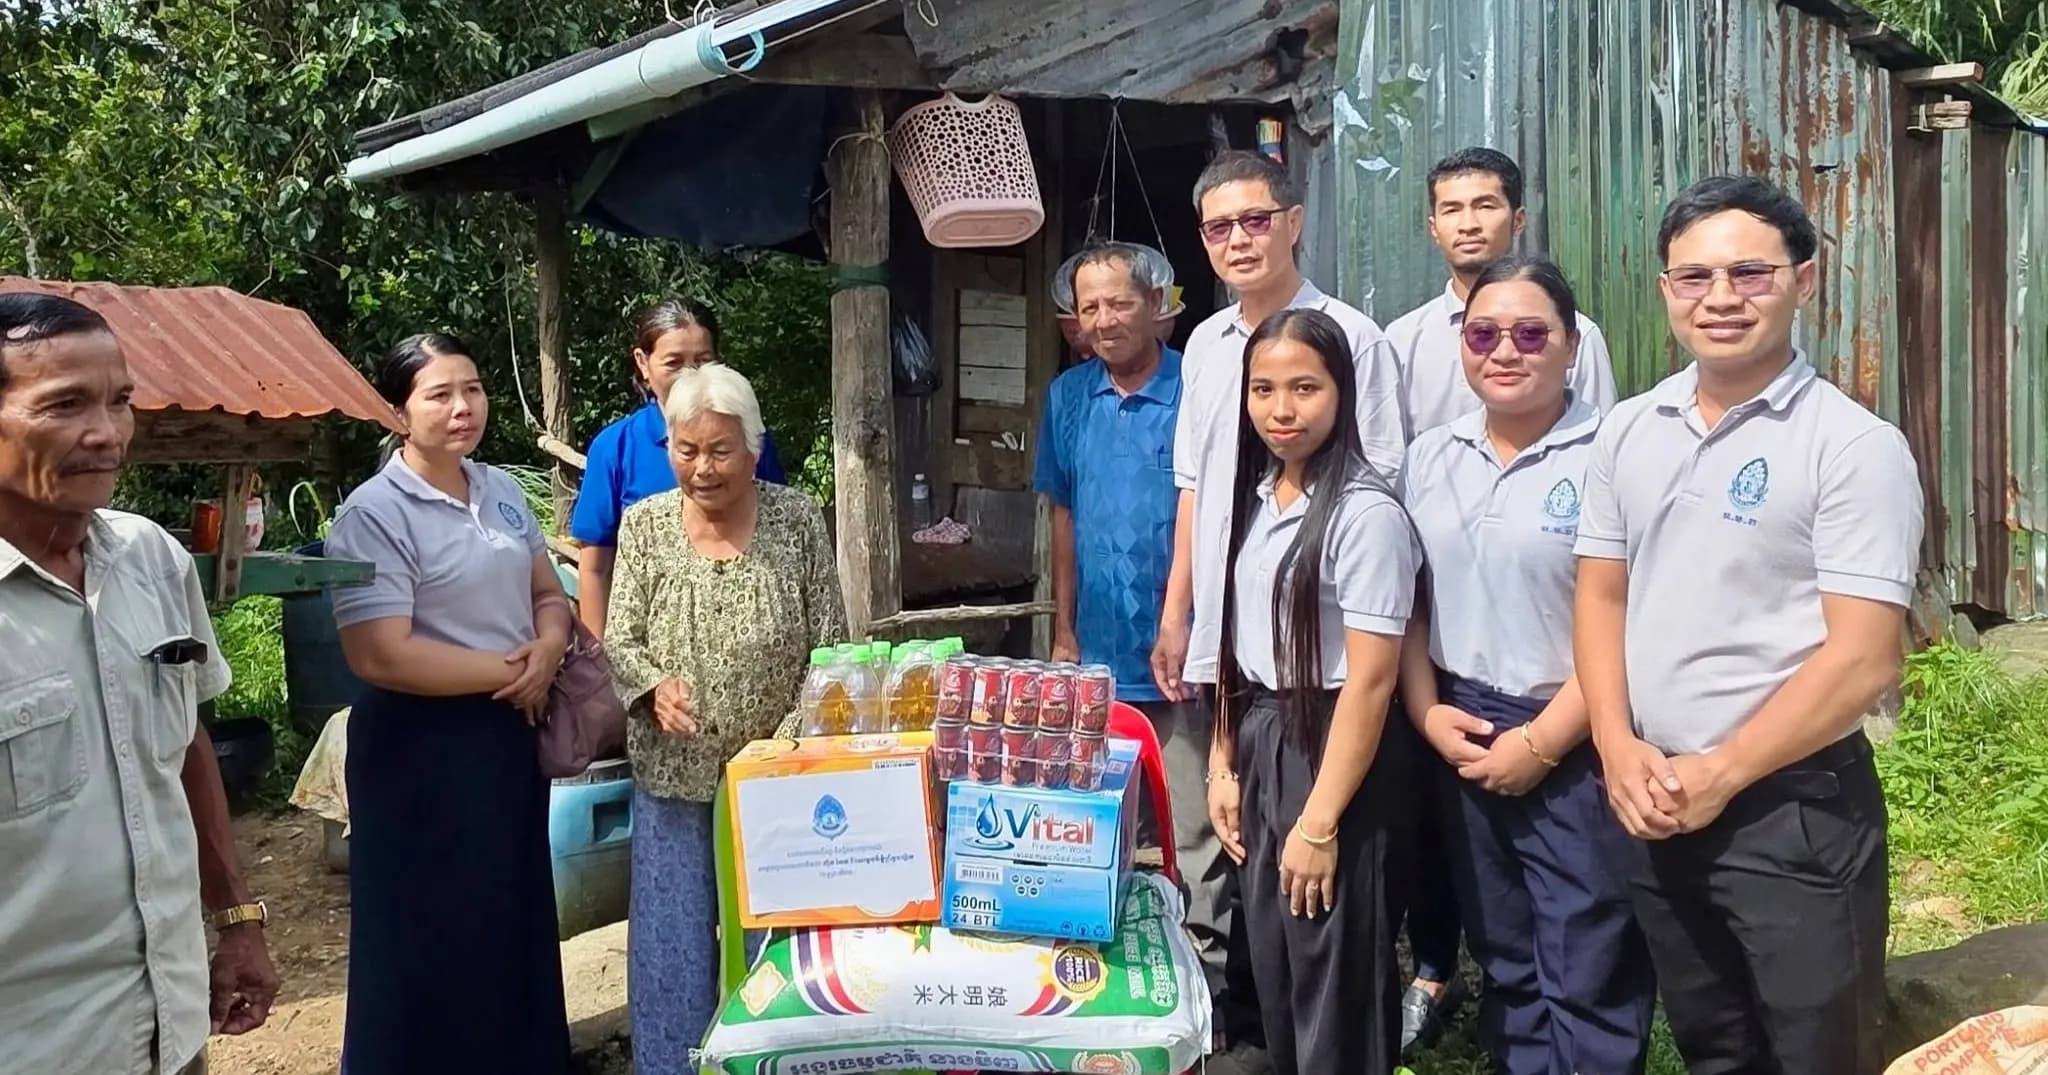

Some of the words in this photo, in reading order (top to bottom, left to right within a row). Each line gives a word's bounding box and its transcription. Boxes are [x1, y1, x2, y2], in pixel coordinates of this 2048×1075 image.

[1004, 802, 1094, 845] Vital
[952, 895, 1001, 911] 500mL
[953, 913, 967, 923] 24
[974, 914, 1000, 927] BTL
[1065, 957, 1075, 983] 100%
[1074, 956, 1084, 983] RICE
[913, 984, 1008, 1008] 娘明大米
